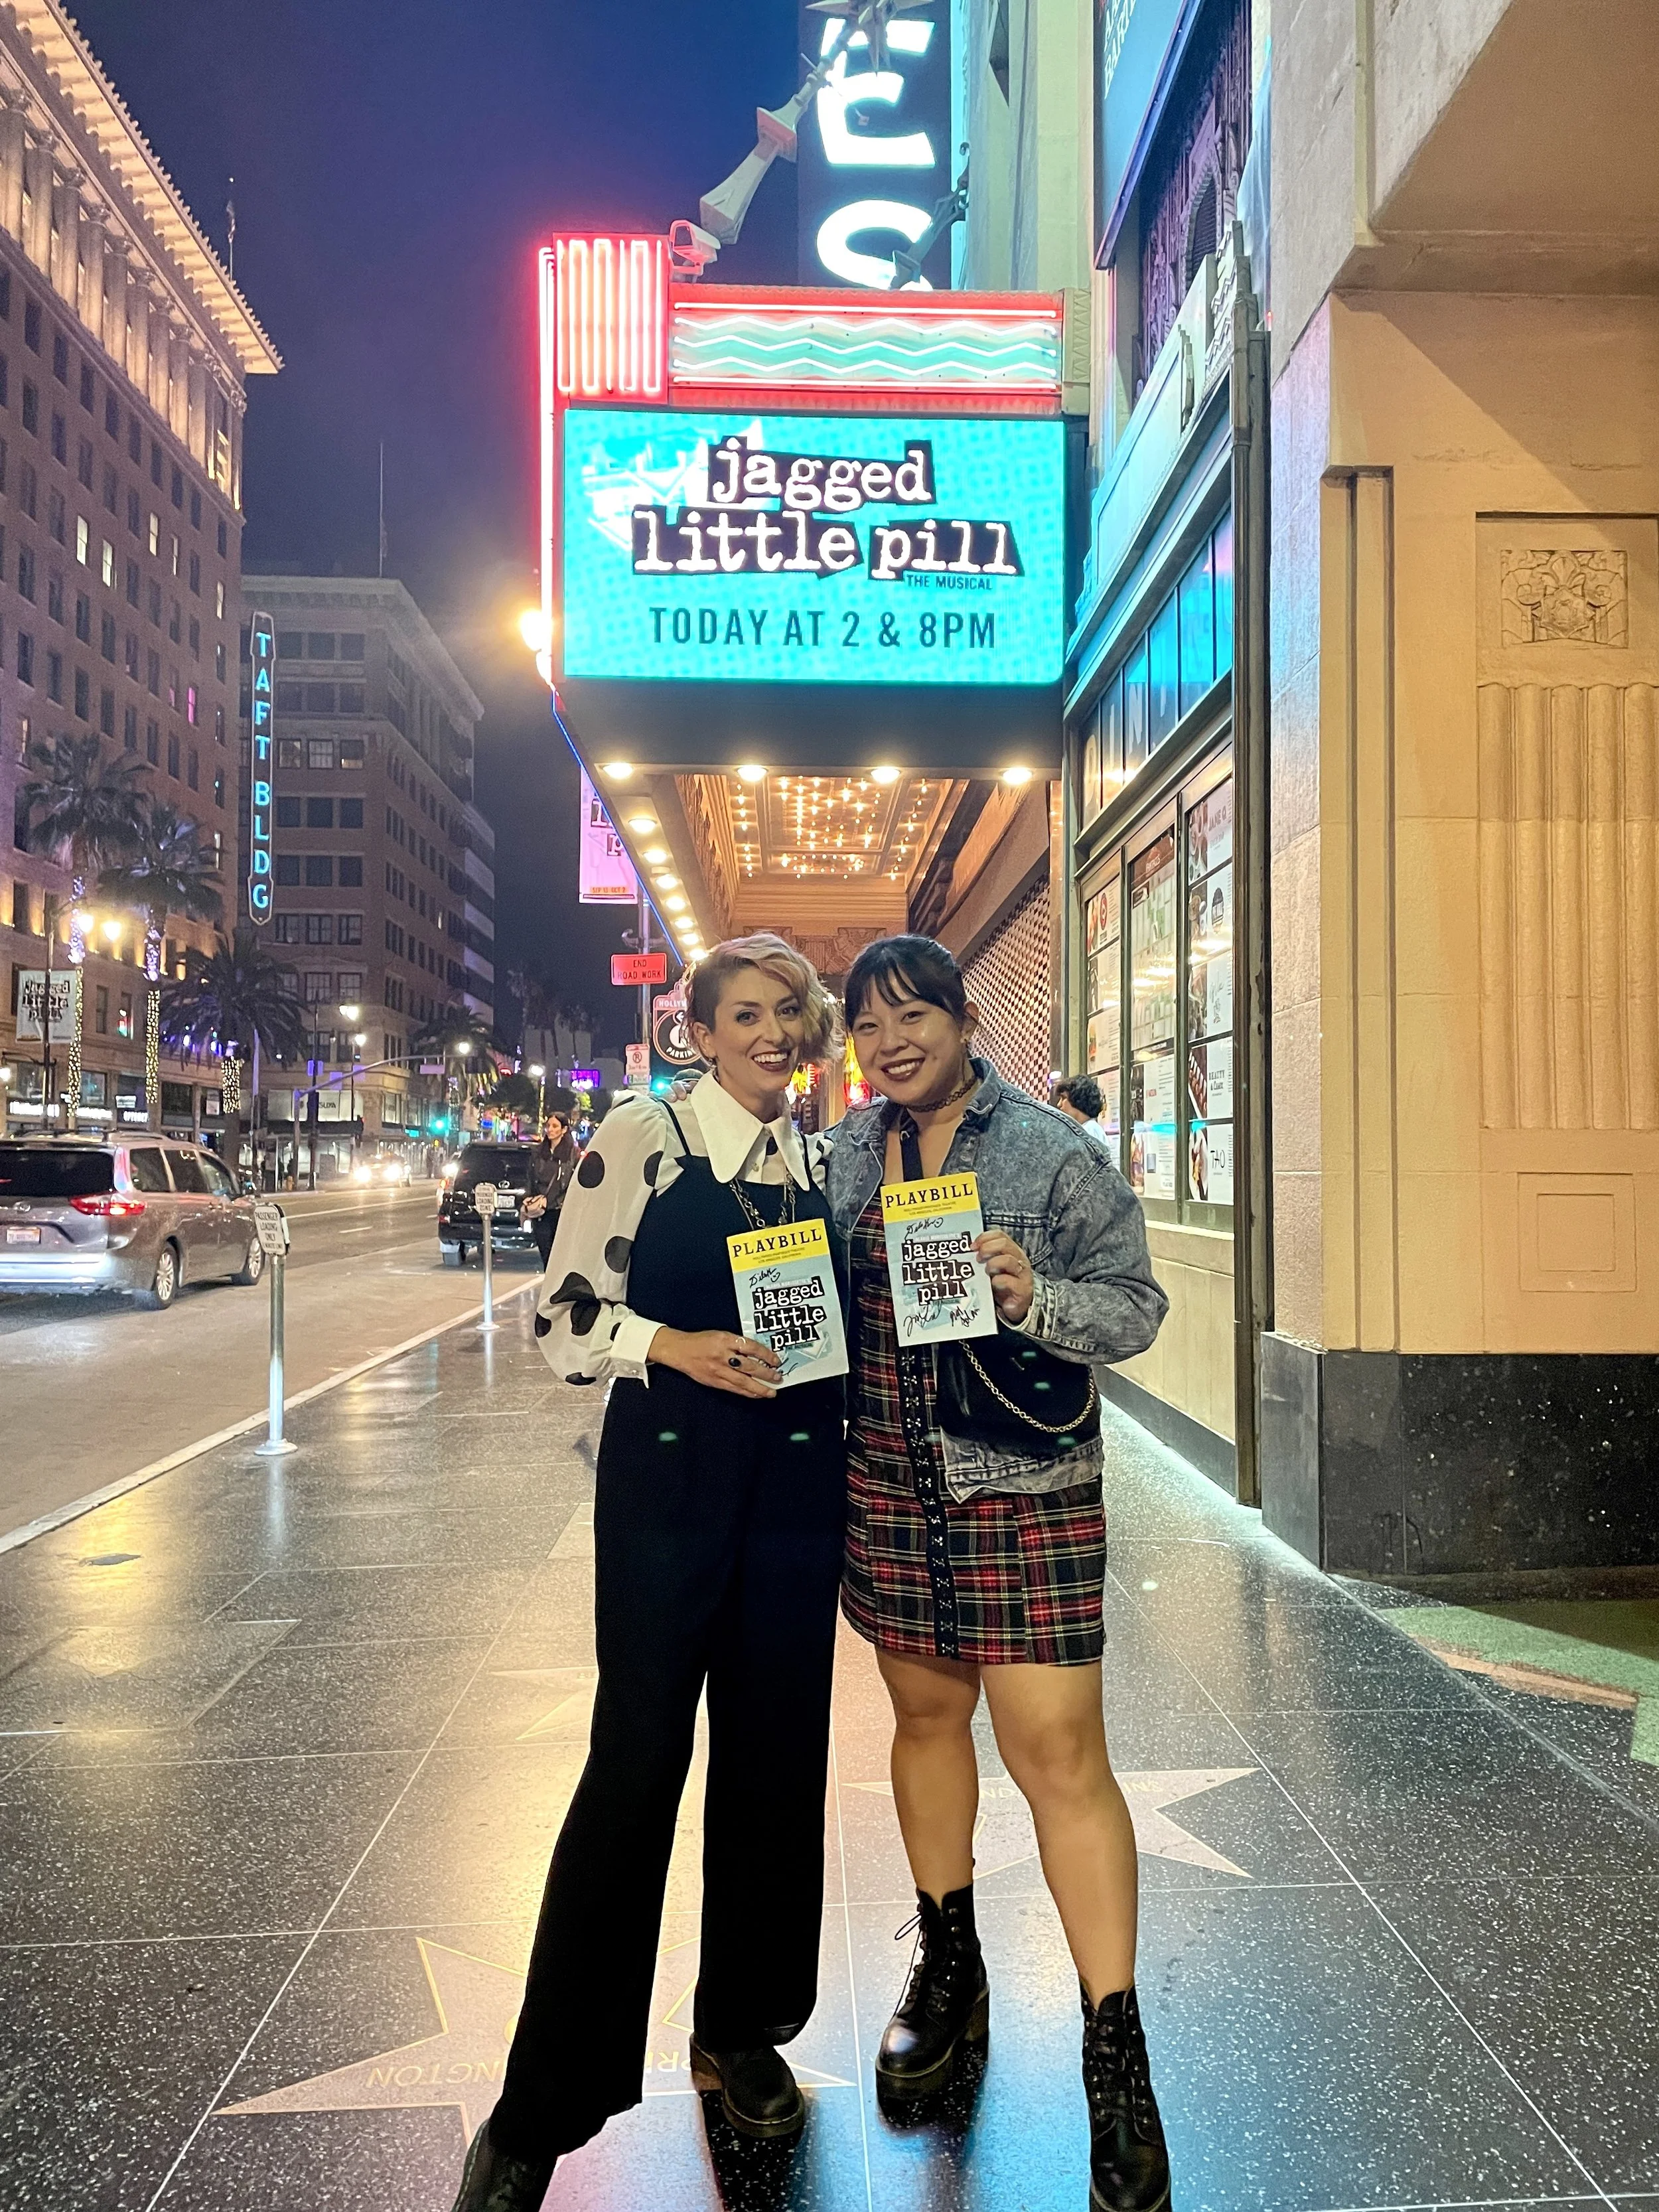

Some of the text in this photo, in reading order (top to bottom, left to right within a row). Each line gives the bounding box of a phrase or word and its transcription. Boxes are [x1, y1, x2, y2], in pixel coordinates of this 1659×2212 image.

[713, 437, 931, 512] jagged
[634, 510, 1017, 579] little pill
[906, 574, 992, 590] THE MUSICAL
[650, 607, 995, 648] TODAY AT 2 & 8PM
[252, 632, 271, 909] TAFT BLDG
[642, 970, 661, 978] WORK
[1210, 1149, 1225, 1169] TAO
[885, 1183, 974, 1208] PLAYBILL
[733, 1229, 822, 1258] PLAYBILL
[904, 1235, 971, 1261] jagged
[904, 1260, 972, 1284] little
[755, 1280, 823, 1309] jagged
[919, 1281, 965, 1305] pill
[754, 1305, 824, 1332] little
[772, 1326, 817, 1351] pill
